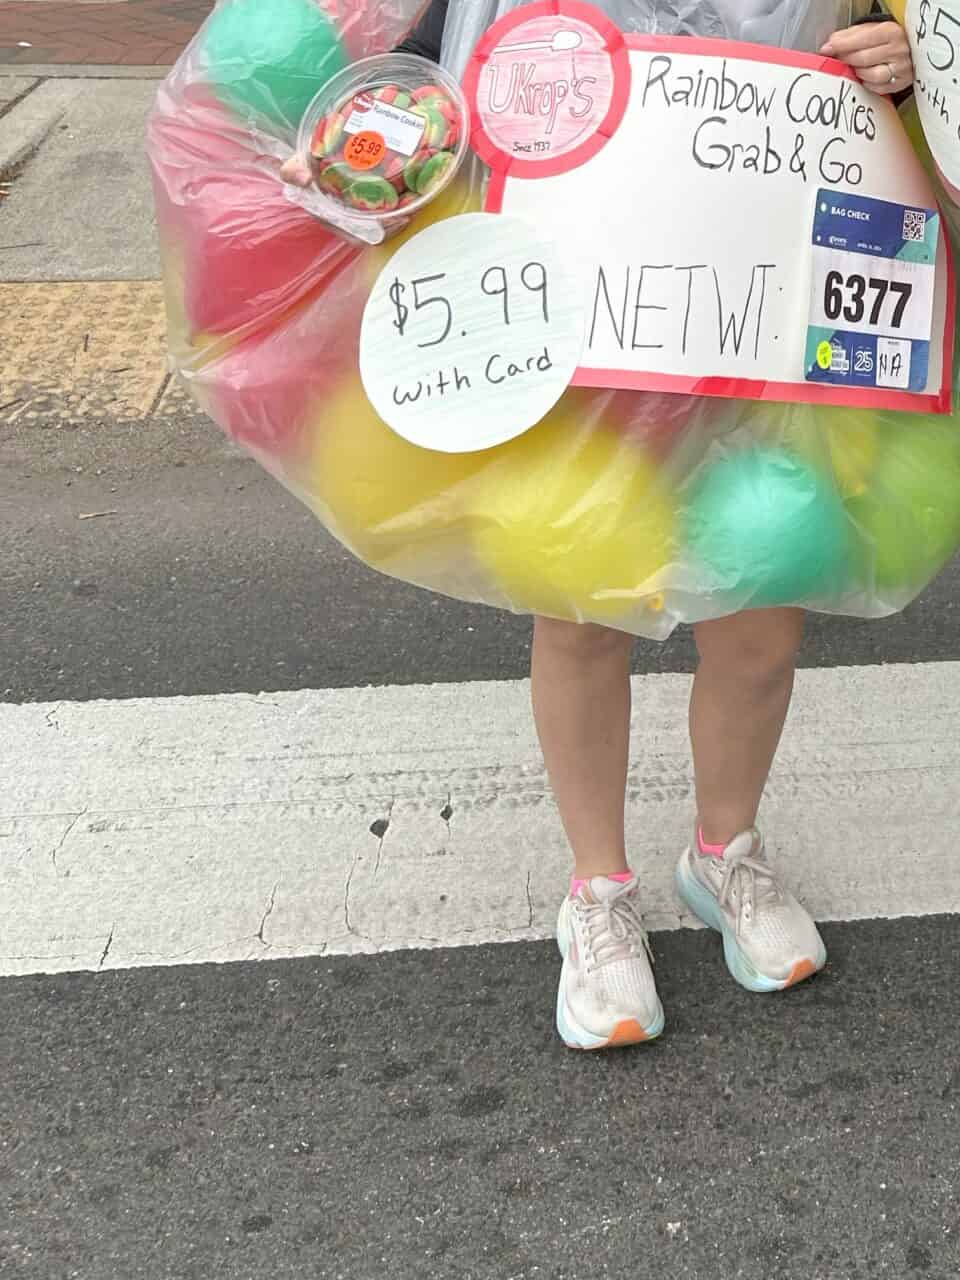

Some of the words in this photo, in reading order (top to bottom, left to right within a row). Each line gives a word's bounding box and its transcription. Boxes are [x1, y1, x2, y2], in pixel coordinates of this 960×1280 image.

[642, 55, 776, 118] Rainbow
[351, 136, 382, 156] $5.99
[692, 116, 782, 175] Grab
[789, 133, 808, 183] &
[818, 137, 863, 185] Go
[831, 206, 846, 217] BAG
[847, 210, 871, 221] CHECK
[389, 261, 550, 349] $5.99
[588, 263, 708, 356] NET
[823, 270, 914, 329] 6377
[392, 367, 471, 407] with
[484, 347, 553, 387] Card
[853, 350, 874, 372] 25
